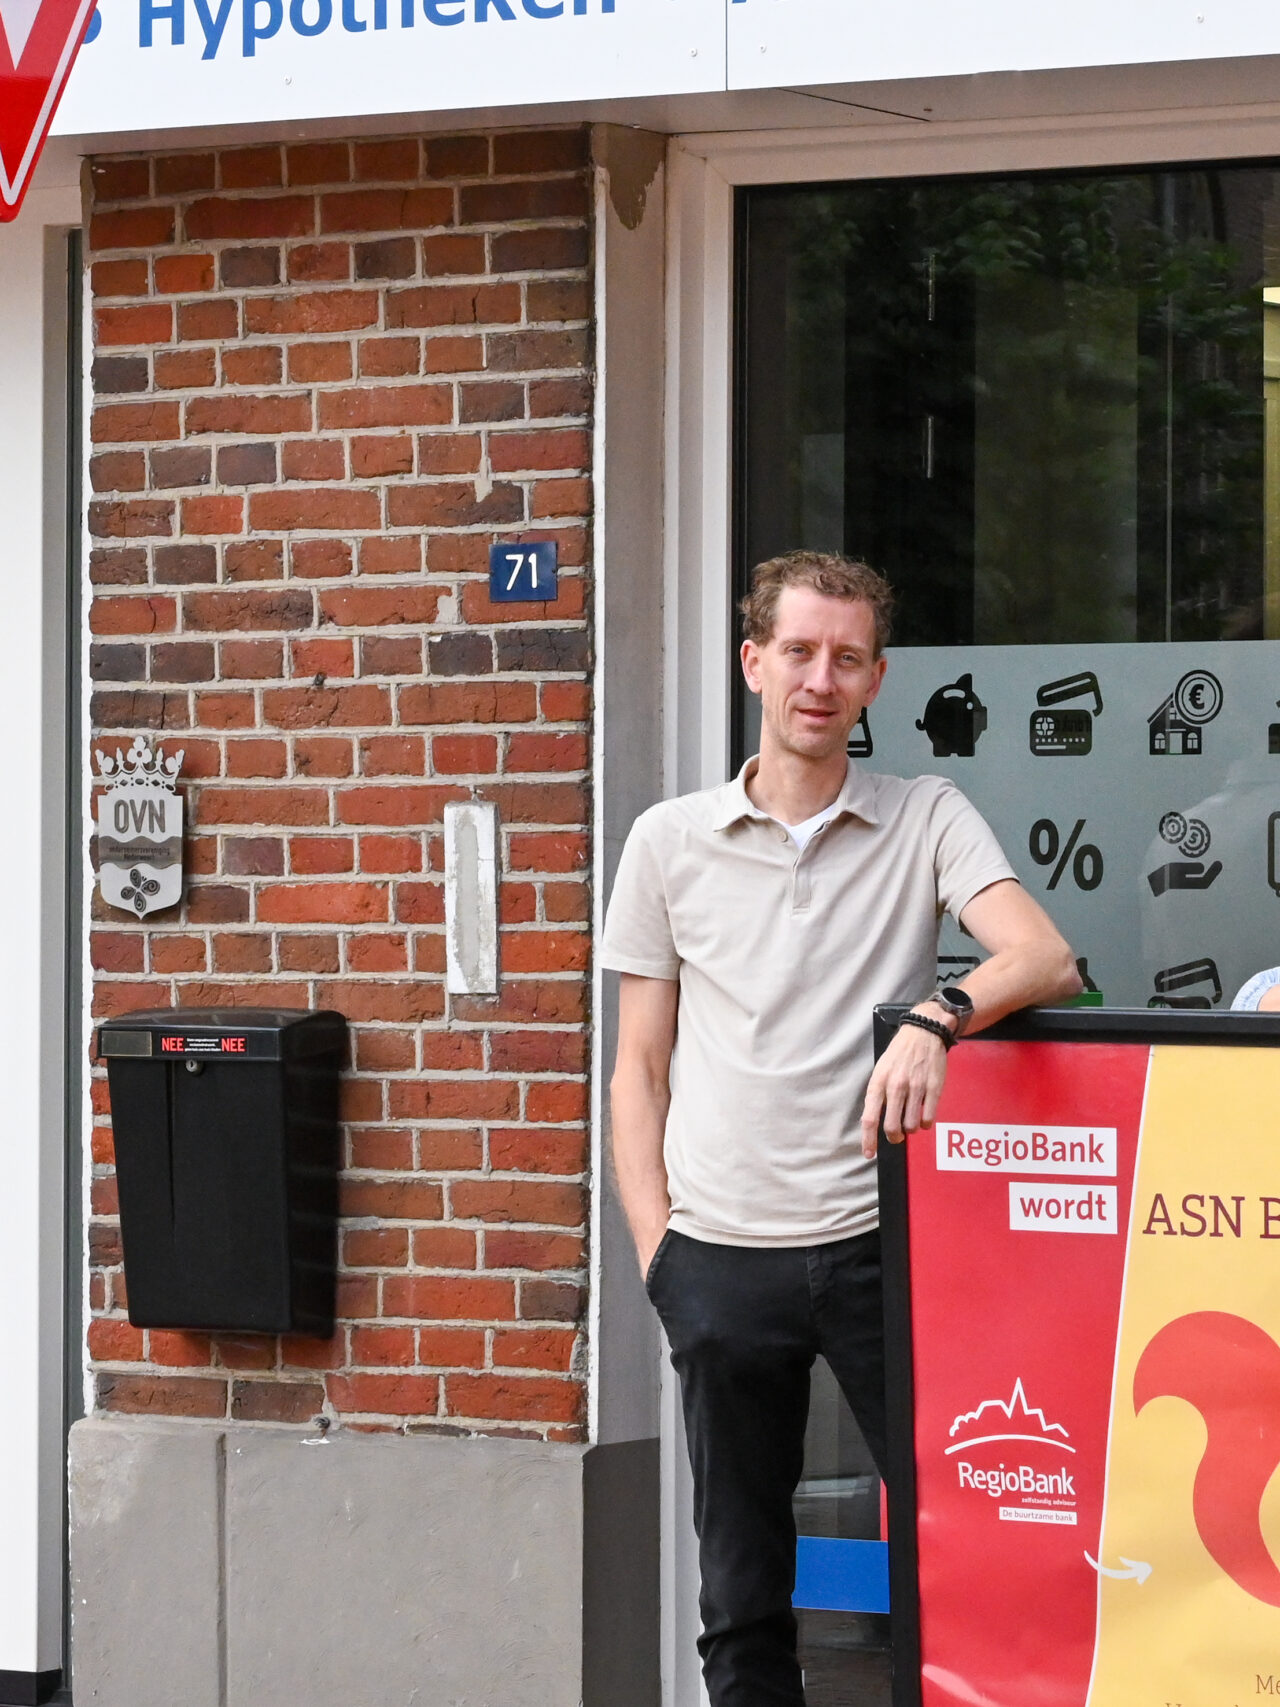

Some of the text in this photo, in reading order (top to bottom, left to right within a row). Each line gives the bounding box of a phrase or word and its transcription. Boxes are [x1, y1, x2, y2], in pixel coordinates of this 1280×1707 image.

[139, 0, 616, 60] Hypote
[505, 552, 538, 591] 71
[114, 799, 166, 834] OVN
[1029, 818, 1104, 891] %
[161, 1037, 246, 1052] NEE NEE
[947, 1129, 1105, 1166] RegioBank
[1019, 1191, 1107, 1222] wordt
[1142, 1193, 1246, 1239] ASN
[958, 1461, 1076, 1497] RegioBank
[1002, 1509, 1013, 1518] De
[1055, 1512, 1073, 1522] bank
